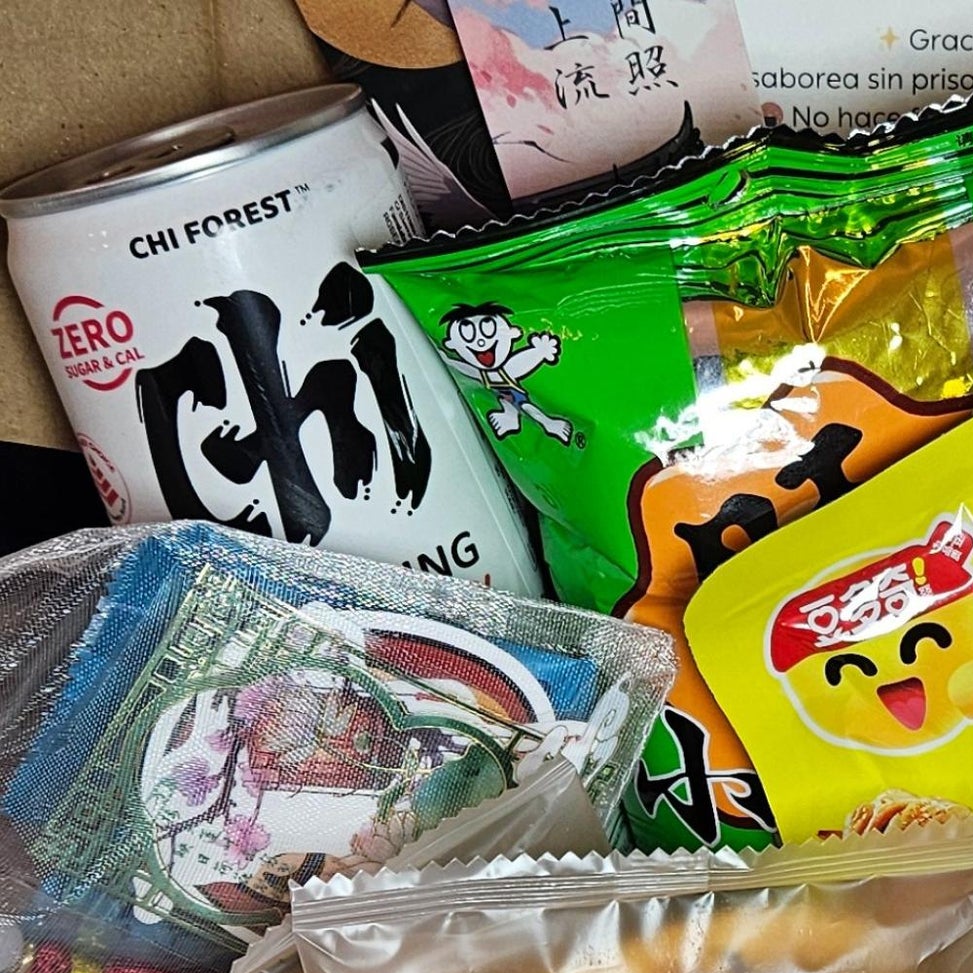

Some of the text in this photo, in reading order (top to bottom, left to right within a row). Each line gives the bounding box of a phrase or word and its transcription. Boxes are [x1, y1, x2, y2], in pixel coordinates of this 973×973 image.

[752, 67, 859, 90] saborea
[868, 67, 903, 90] sin
[793, 106, 829, 128] No
[838, 106, 901, 128] hace
[129, 227, 180, 260] CHI
[184, 189, 291, 244] FOREST
[51, 310, 134, 360] ZERO
[65, 346, 146, 379] SUGAR & CAL
[402, 531, 480, 577] NG
